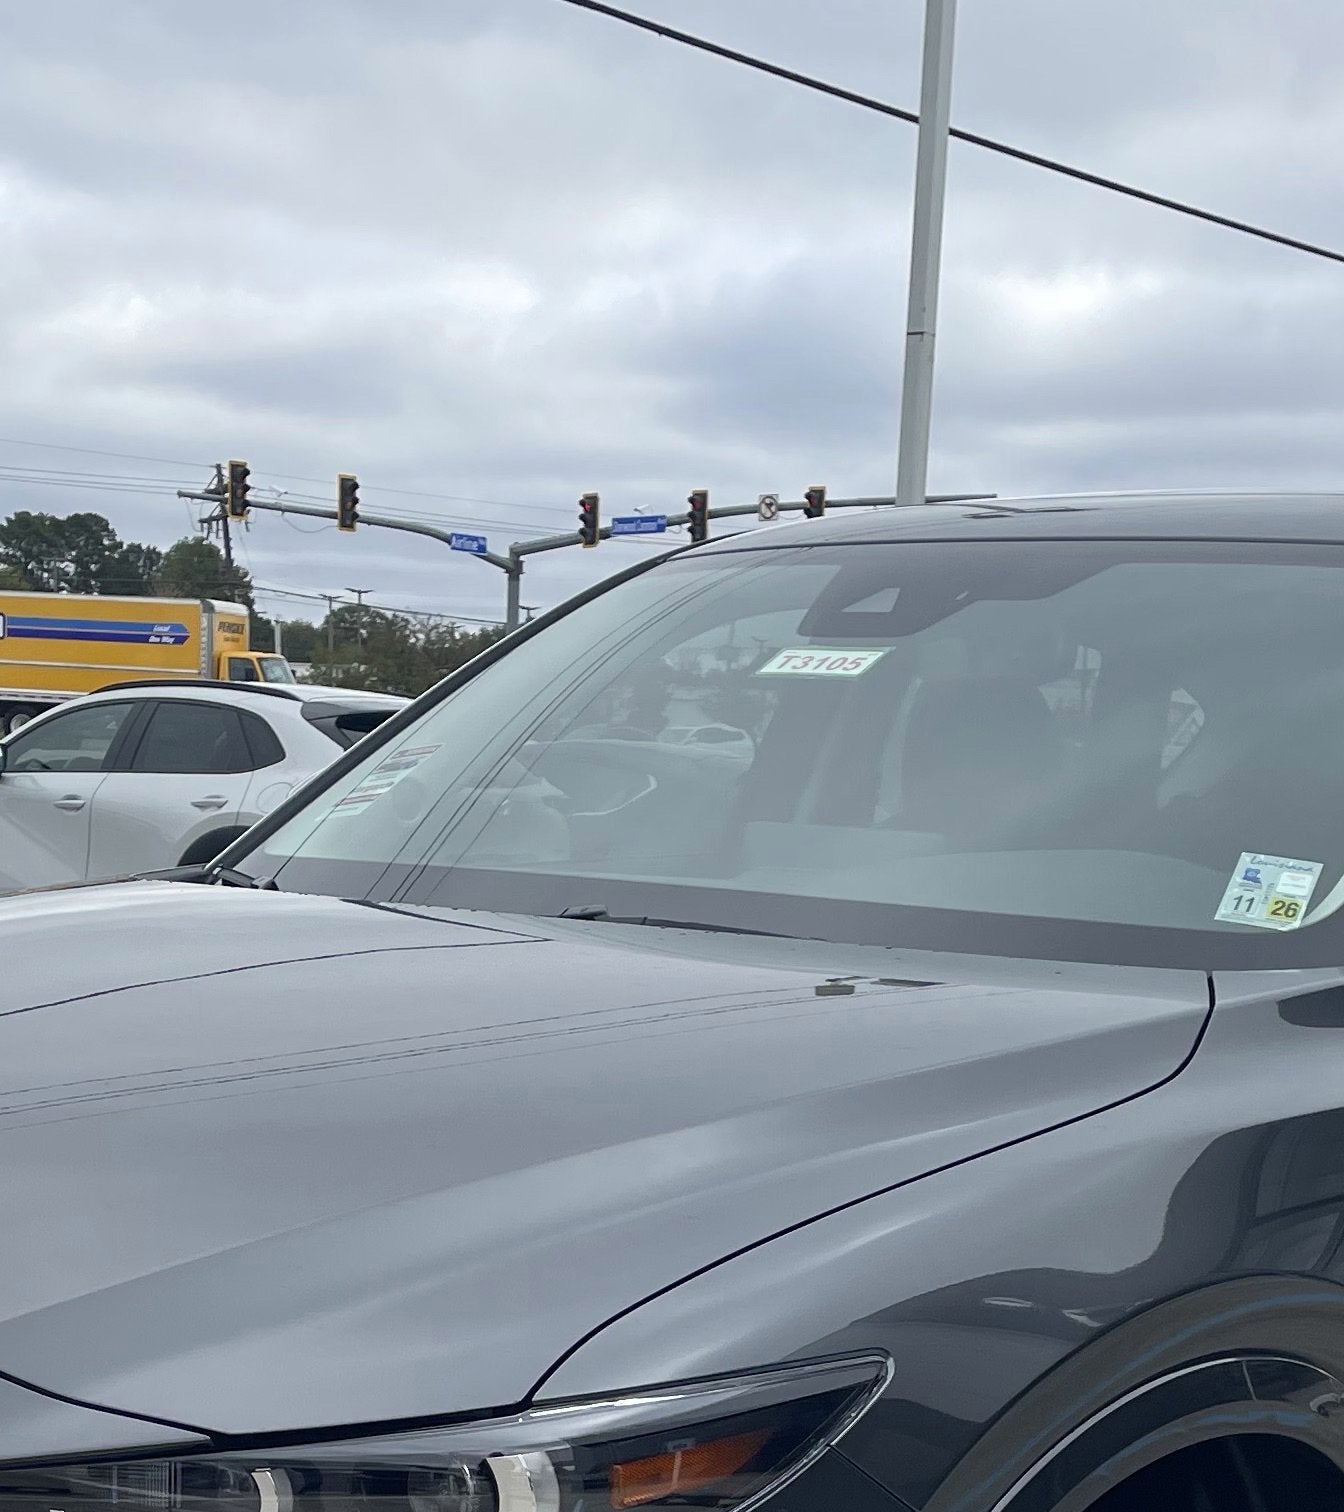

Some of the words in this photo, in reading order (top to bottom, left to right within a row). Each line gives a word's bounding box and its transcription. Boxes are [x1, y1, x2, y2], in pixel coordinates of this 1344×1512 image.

[776, 655, 867, 671] T3105
[1233, 895, 1256, 912] 11
[1271, 900, 1300, 918] 26
